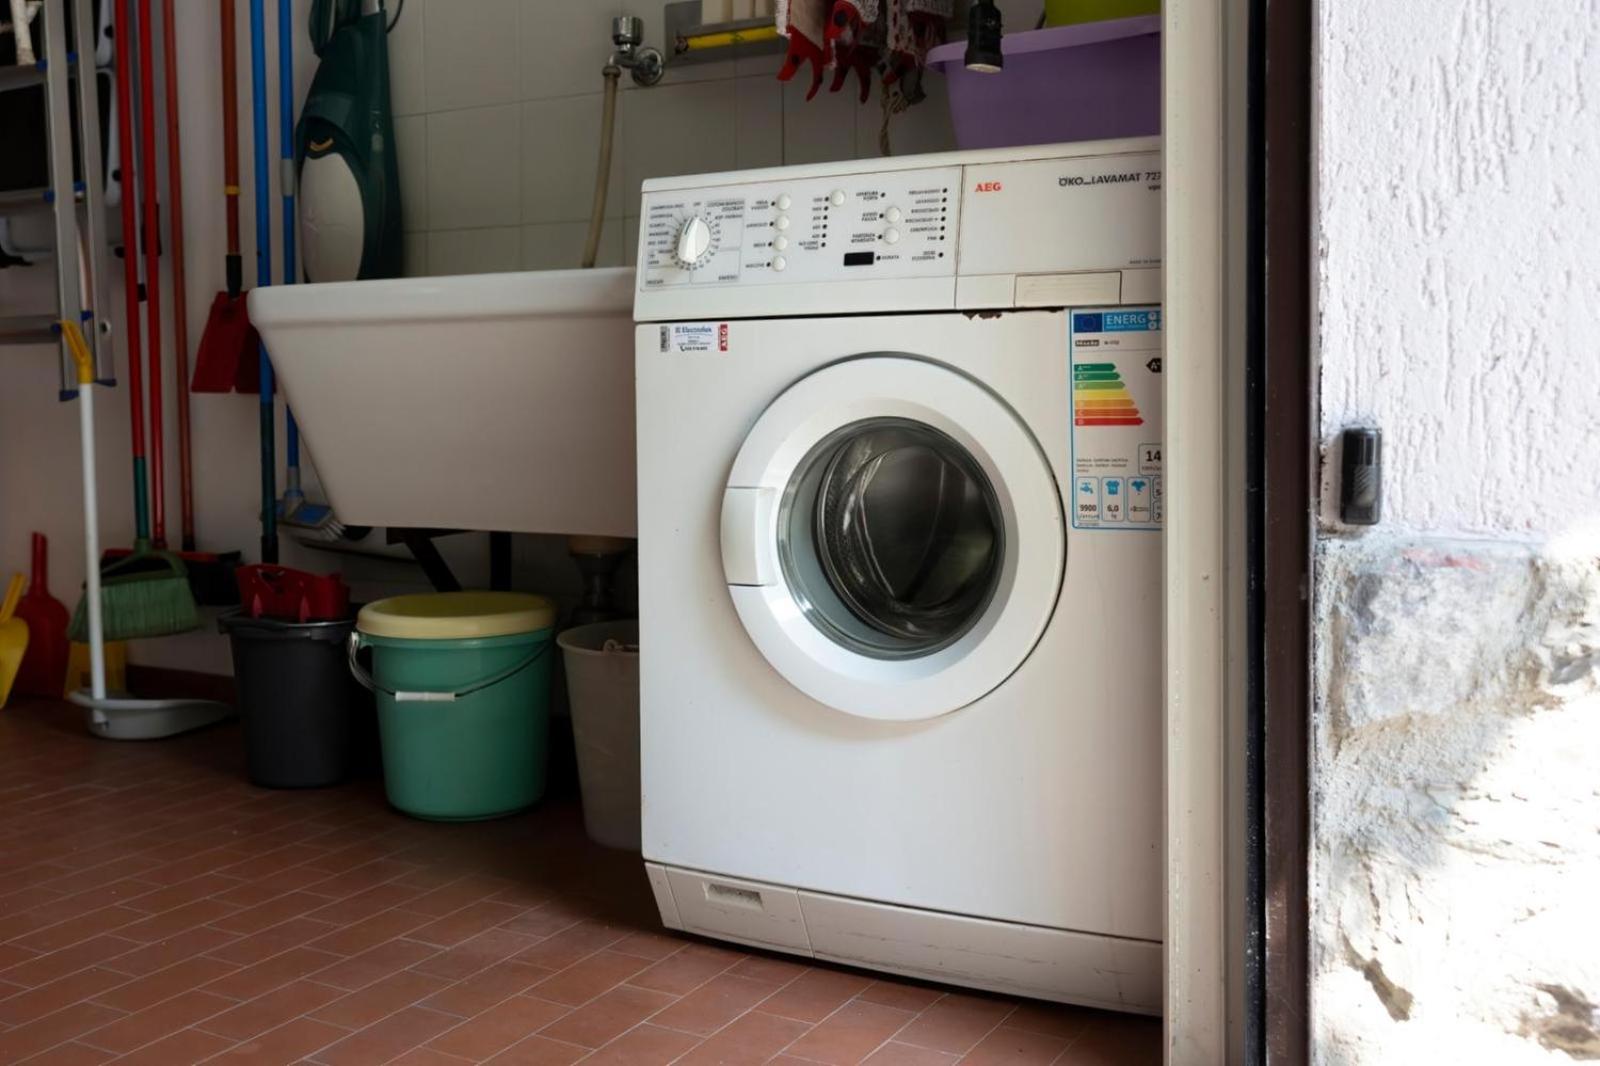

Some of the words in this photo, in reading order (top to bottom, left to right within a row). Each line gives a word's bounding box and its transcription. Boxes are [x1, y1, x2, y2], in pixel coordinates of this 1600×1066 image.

[974, 182, 1002, 193] AEG
[1105, 314, 1147, 325] ENERG
[682, 325, 712, 333] Electrolux
[1079, 504, 1097, 512] 9900
